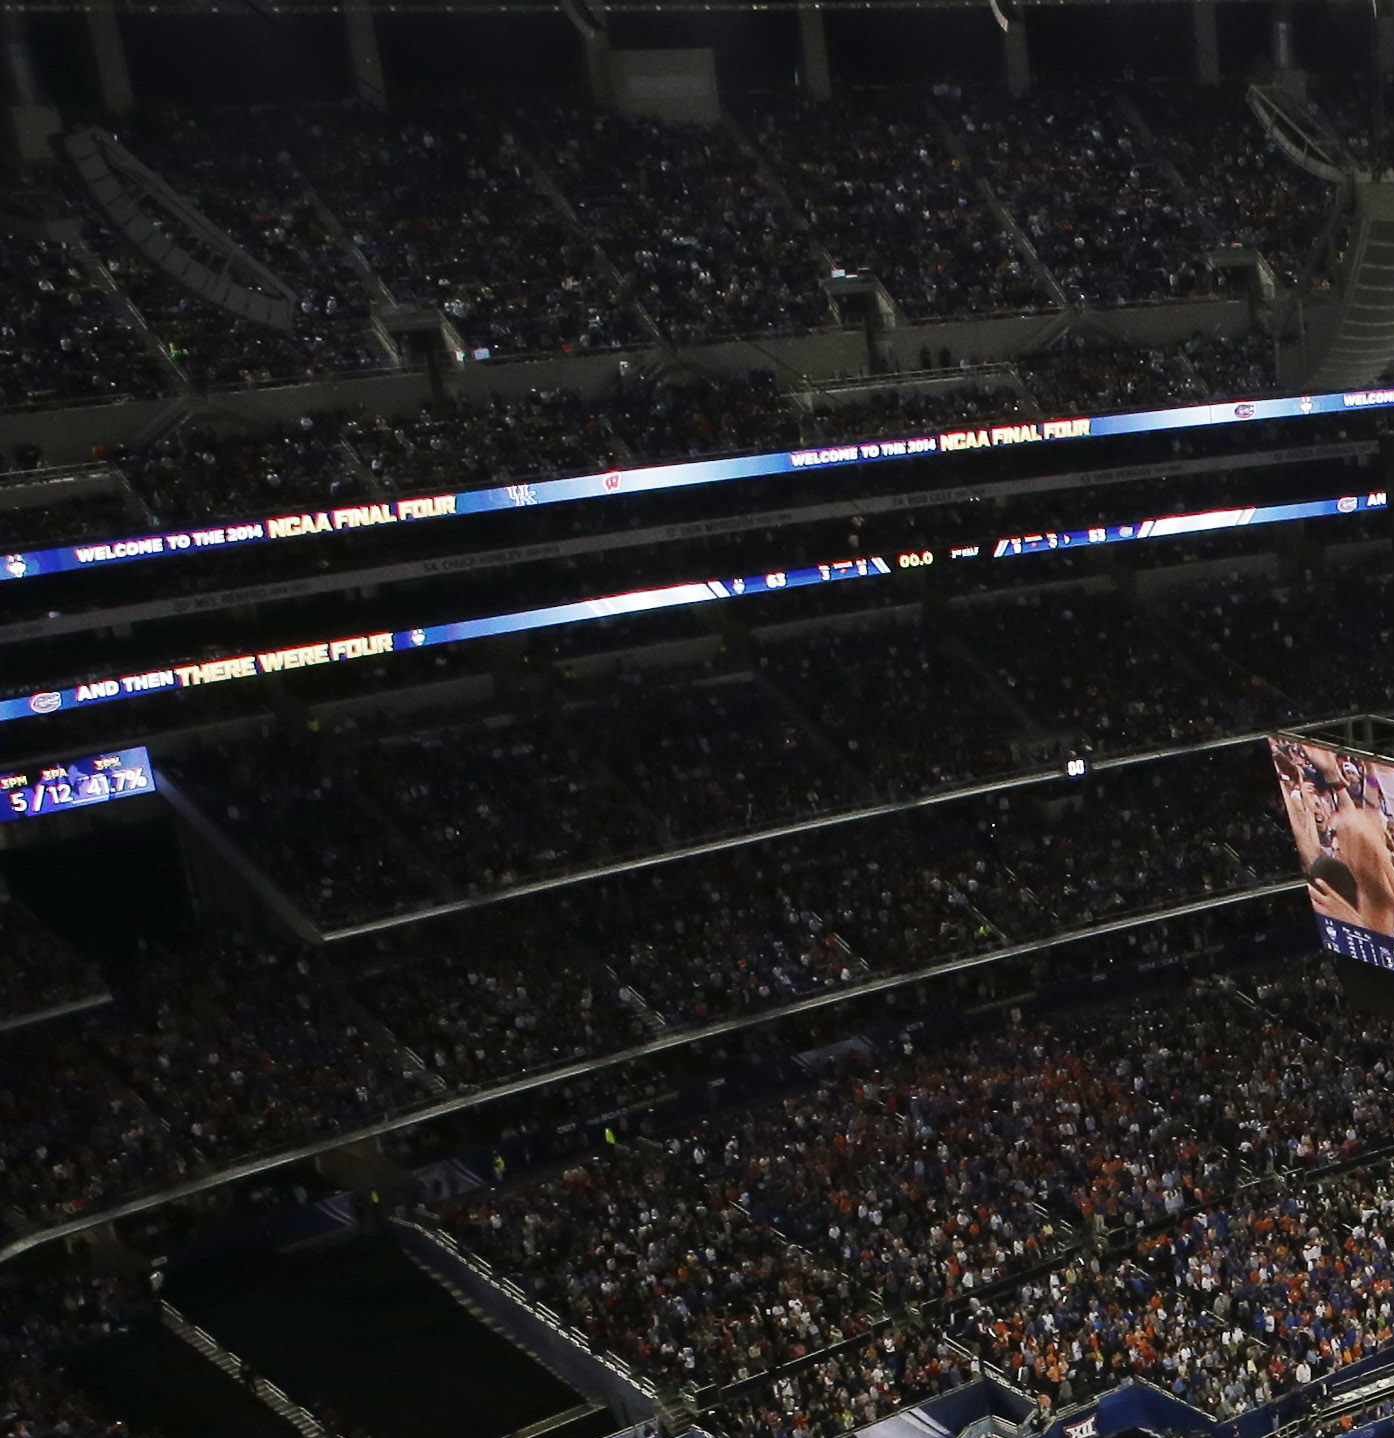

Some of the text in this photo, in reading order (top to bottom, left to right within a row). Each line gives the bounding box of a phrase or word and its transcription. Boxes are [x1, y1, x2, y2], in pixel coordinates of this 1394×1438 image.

[791, 419, 1091, 467] WELCOME TO THE 2014 NCAA FINAL FOUR
[1367, 492, 1387, 507] AN
[76, 495, 456, 563] WELCOME TO THE 2014 NCAA FINAL FOUR
[900, 551, 933, 567] 00.0
[77, 632, 393, 701] AND THEN THERE WERE FOUR
[1, 757, 121, 789] 3PM 3PA 3P%
[88, 768, 148, 795] 41.7%
